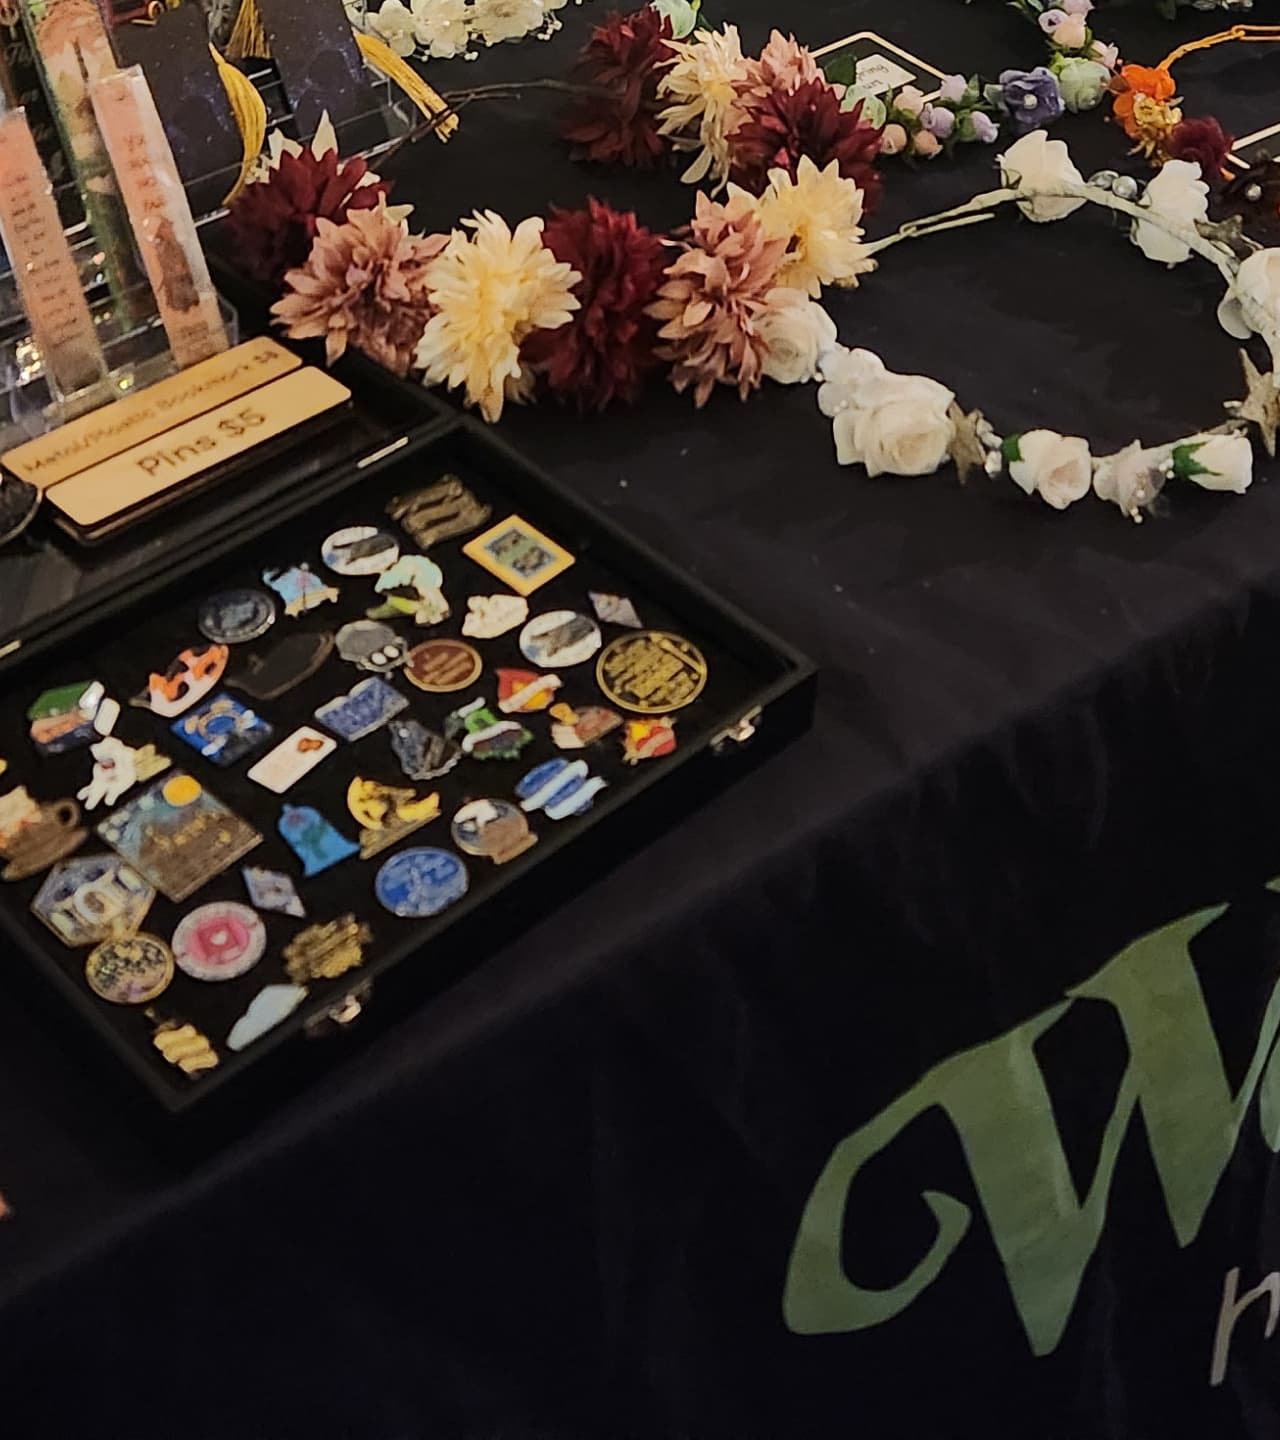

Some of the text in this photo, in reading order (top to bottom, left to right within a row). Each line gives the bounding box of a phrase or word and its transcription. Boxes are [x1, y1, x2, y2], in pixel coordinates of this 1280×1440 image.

[156, 363, 251, 420] Bookmark
[134, 406, 269, 479] Pins $5
